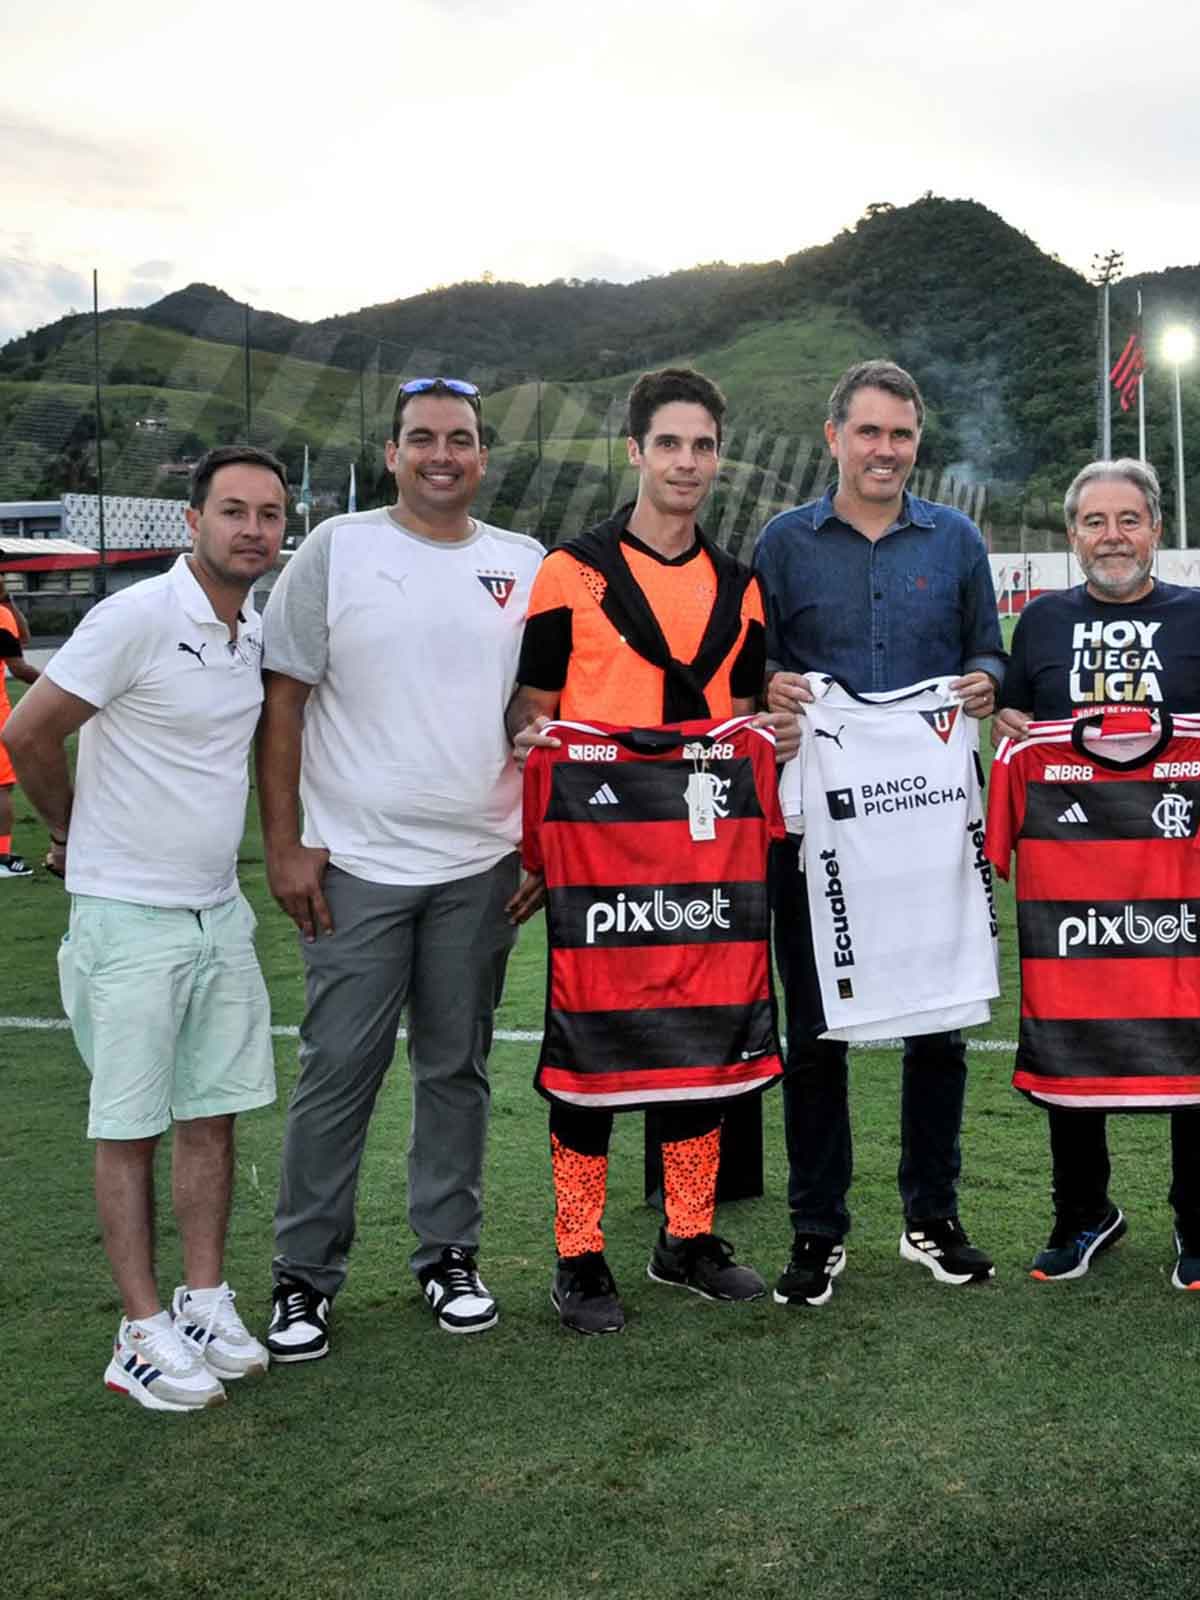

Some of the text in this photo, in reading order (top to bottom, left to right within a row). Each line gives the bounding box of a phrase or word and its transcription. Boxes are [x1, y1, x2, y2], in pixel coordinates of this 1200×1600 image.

[1072, 620, 1162, 649] HOY
[1072, 650, 1163, 672] JUEGA
[1069, 671, 1164, 702] LIGA
[932, 711, 951, 734] U
[583, 744, 618, 761] BRB
[700, 743, 735, 760] BRB
[1060, 764, 1094, 781] BRB
[861, 775, 928, 800] BANCO
[864, 786, 967, 817] PICHINCHA
[586, 888, 731, 944] pixbet
[819, 848, 855, 968] Ecuabet
[1058, 903, 1197, 957] pixbet
